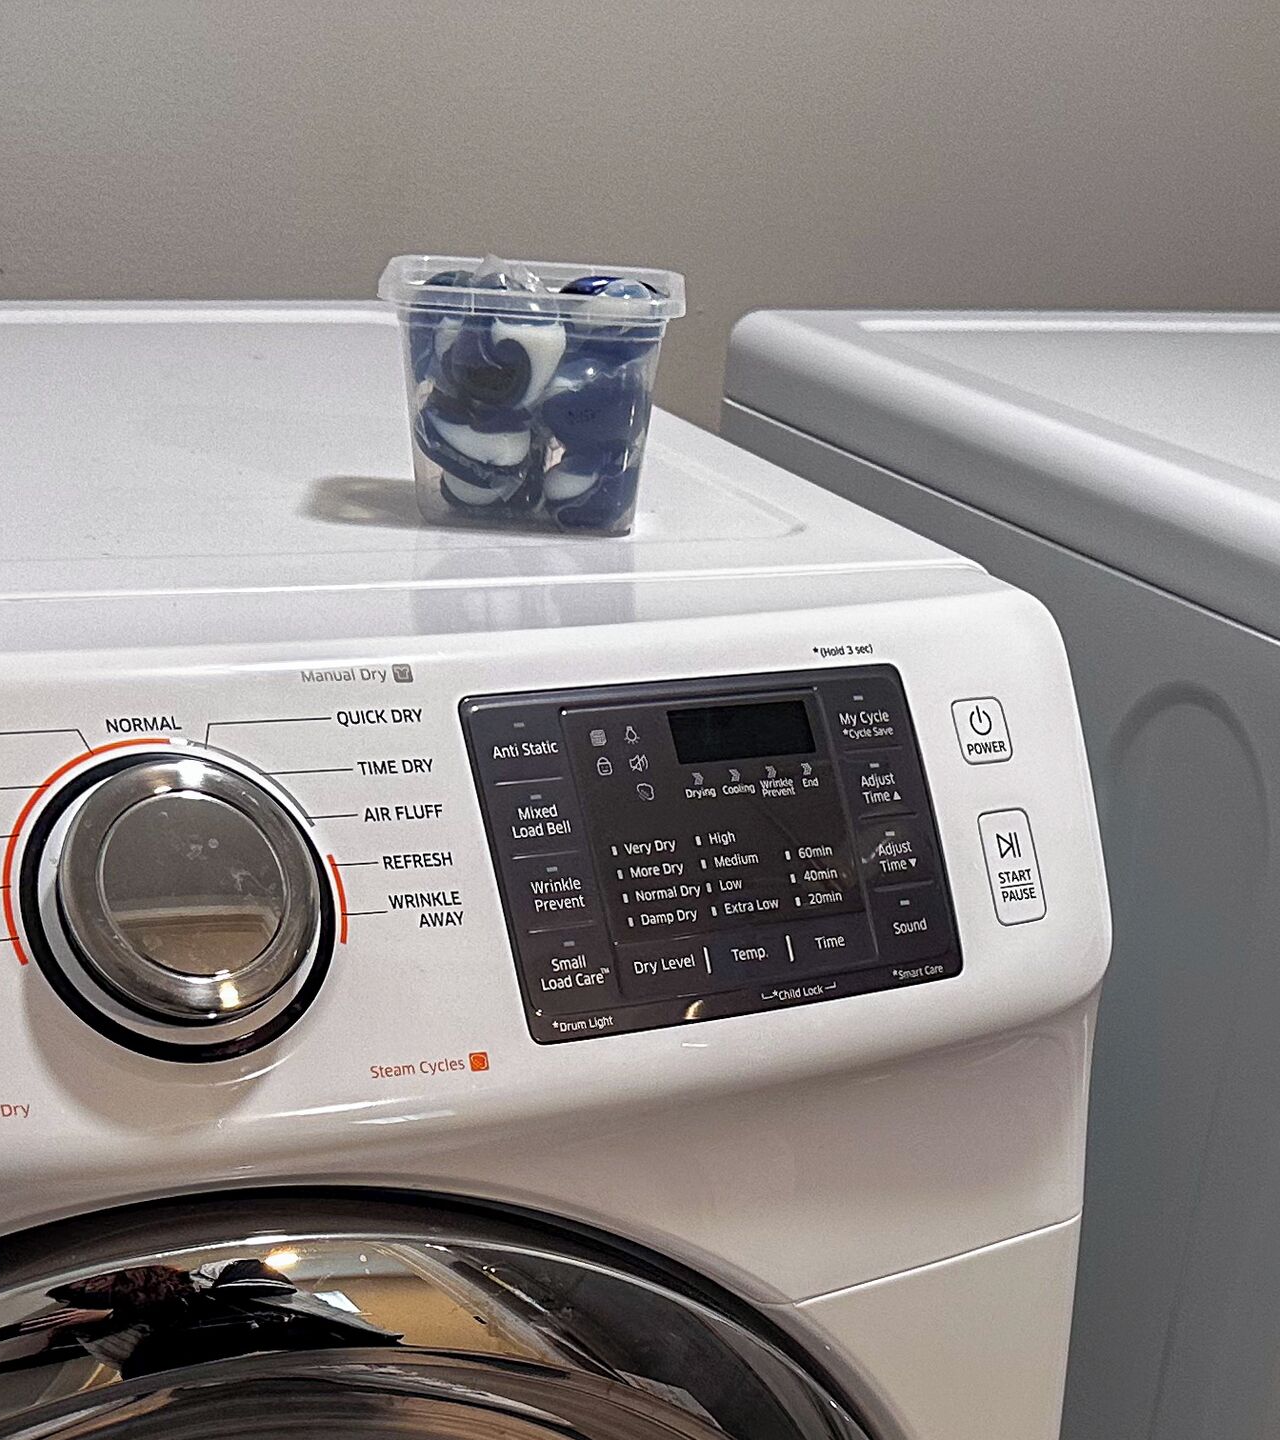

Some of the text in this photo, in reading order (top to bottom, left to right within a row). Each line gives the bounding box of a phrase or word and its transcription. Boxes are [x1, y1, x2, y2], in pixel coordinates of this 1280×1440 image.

[847, 645, 854, 655] 3
[855, 643, 873, 655] sec)
[300, 667, 387, 683] Manual Dry
[105, 715, 183, 733] NORMAL
[336, 708, 423, 727] QUICK DRY
[838, 709, 890, 727] My Cycle
[873, 726, 894, 737] Save
[492, 740, 559, 760] Anti Static
[966, 740, 1007, 756] POWER
[356, 758, 434, 775] TIME DRY
[759, 777, 794, 789] Wrinkle
[802, 777, 819, 788] End
[860, 772, 896, 788] Adjust
[685, 787, 717, 799] Drying
[722, 783, 756, 795] Cooling
[762, 787, 796, 798] Prevent
[862, 791, 891, 804] Time
[363, 804, 443, 823] AIR FLUFF
[517, 804, 558, 821] Mixed
[511, 819, 572, 839] Load Bell
[708, 831, 736, 846] High
[623, 839, 676, 856] Very Dry
[798, 844, 833, 859] 60min
[878, 840, 913, 857] Adjust
[382, 851, 453, 870] REFRESH
[713, 853, 759, 868] Medium
[880, 859, 907, 873] Time
[629, 862, 684, 879] More Dry
[803, 867, 838, 882] 40min
[998, 868, 1032, 884] START
[530, 877, 582, 895] Wrinkle
[634, 884, 701, 902] Normal Dry
[719, 878, 743, 892] Low
[388, 890, 462, 910] WRINKLE
[534, 894, 586, 912] Prevent
[808, 890, 843, 905] 20min
[1001, 887, 1037, 903] PAUSE
[724, 897, 779, 915] Extra Low
[419, 910, 464, 928] AWAY
[640, 909, 698, 927] Damp Dry
[893, 917, 928, 935] Sound
[814, 934, 846, 950] Time
[731, 946, 769, 962] Temp.
[551, 954, 587, 972] Small
[633, 954, 696, 975] Dry Level
[924, 964, 944, 977] Care
[540, 974, 573, 991] Load
[802, 984, 823, 997] Lock
[588, 1015, 614, 1030] Light
[369, 1058, 466, 1079] Steam Cycles
[0, 1103, 30, 1119] Dry
